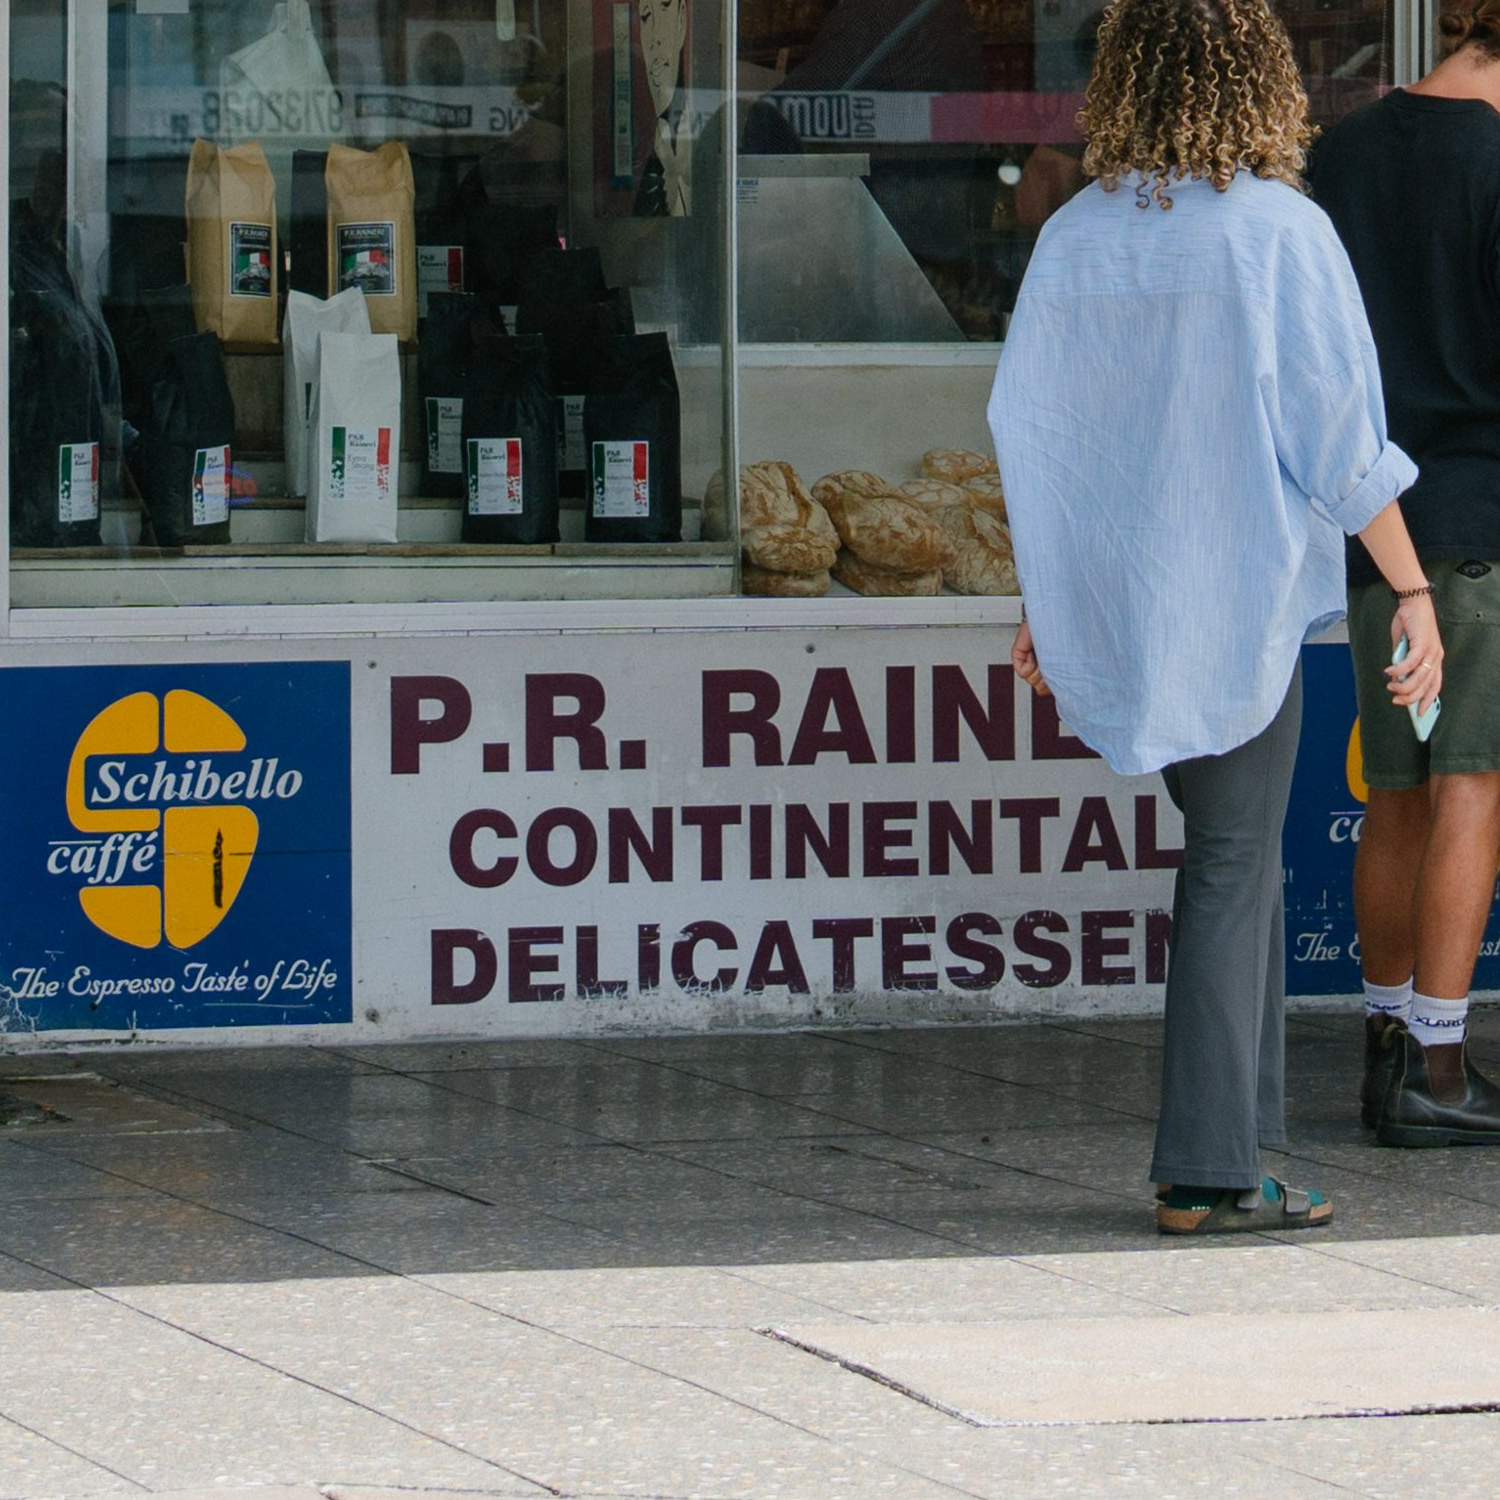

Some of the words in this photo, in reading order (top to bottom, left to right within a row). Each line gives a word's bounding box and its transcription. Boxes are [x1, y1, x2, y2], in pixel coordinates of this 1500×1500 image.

[90, 757, 303, 804] Schibello
[447, 794, 1185, 890] CONTINENTAL
[1294, 932, 1341, 963] The
[11, 966, 60, 999] The
[67, 965, 176, 1005] Espresso
[253, 960, 285, 1001] of
[281, 958, 338, 1000] Life
